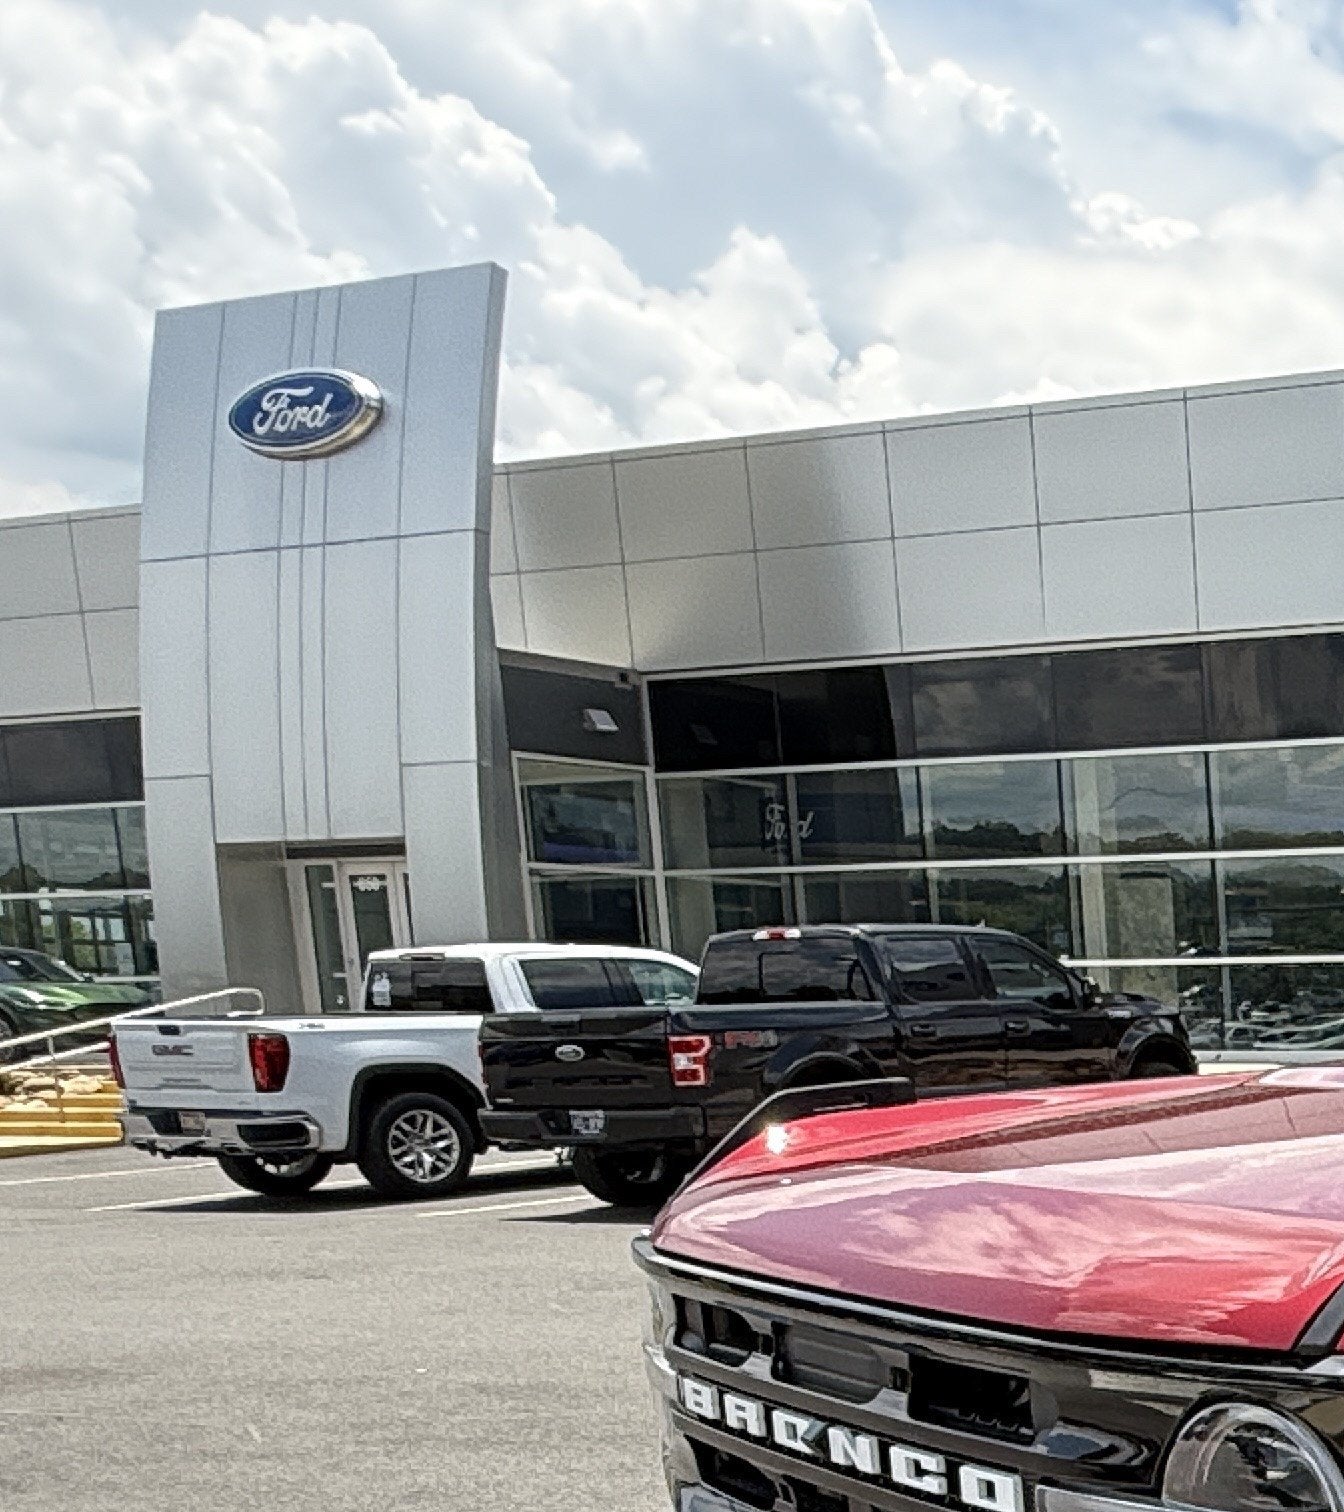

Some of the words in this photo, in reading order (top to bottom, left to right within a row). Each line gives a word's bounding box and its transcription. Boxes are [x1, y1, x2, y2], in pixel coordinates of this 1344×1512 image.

[252, 386, 334, 435] Ford
[765, 803, 814, 839] Fod
[151, 1044, 194, 1056] GMC
